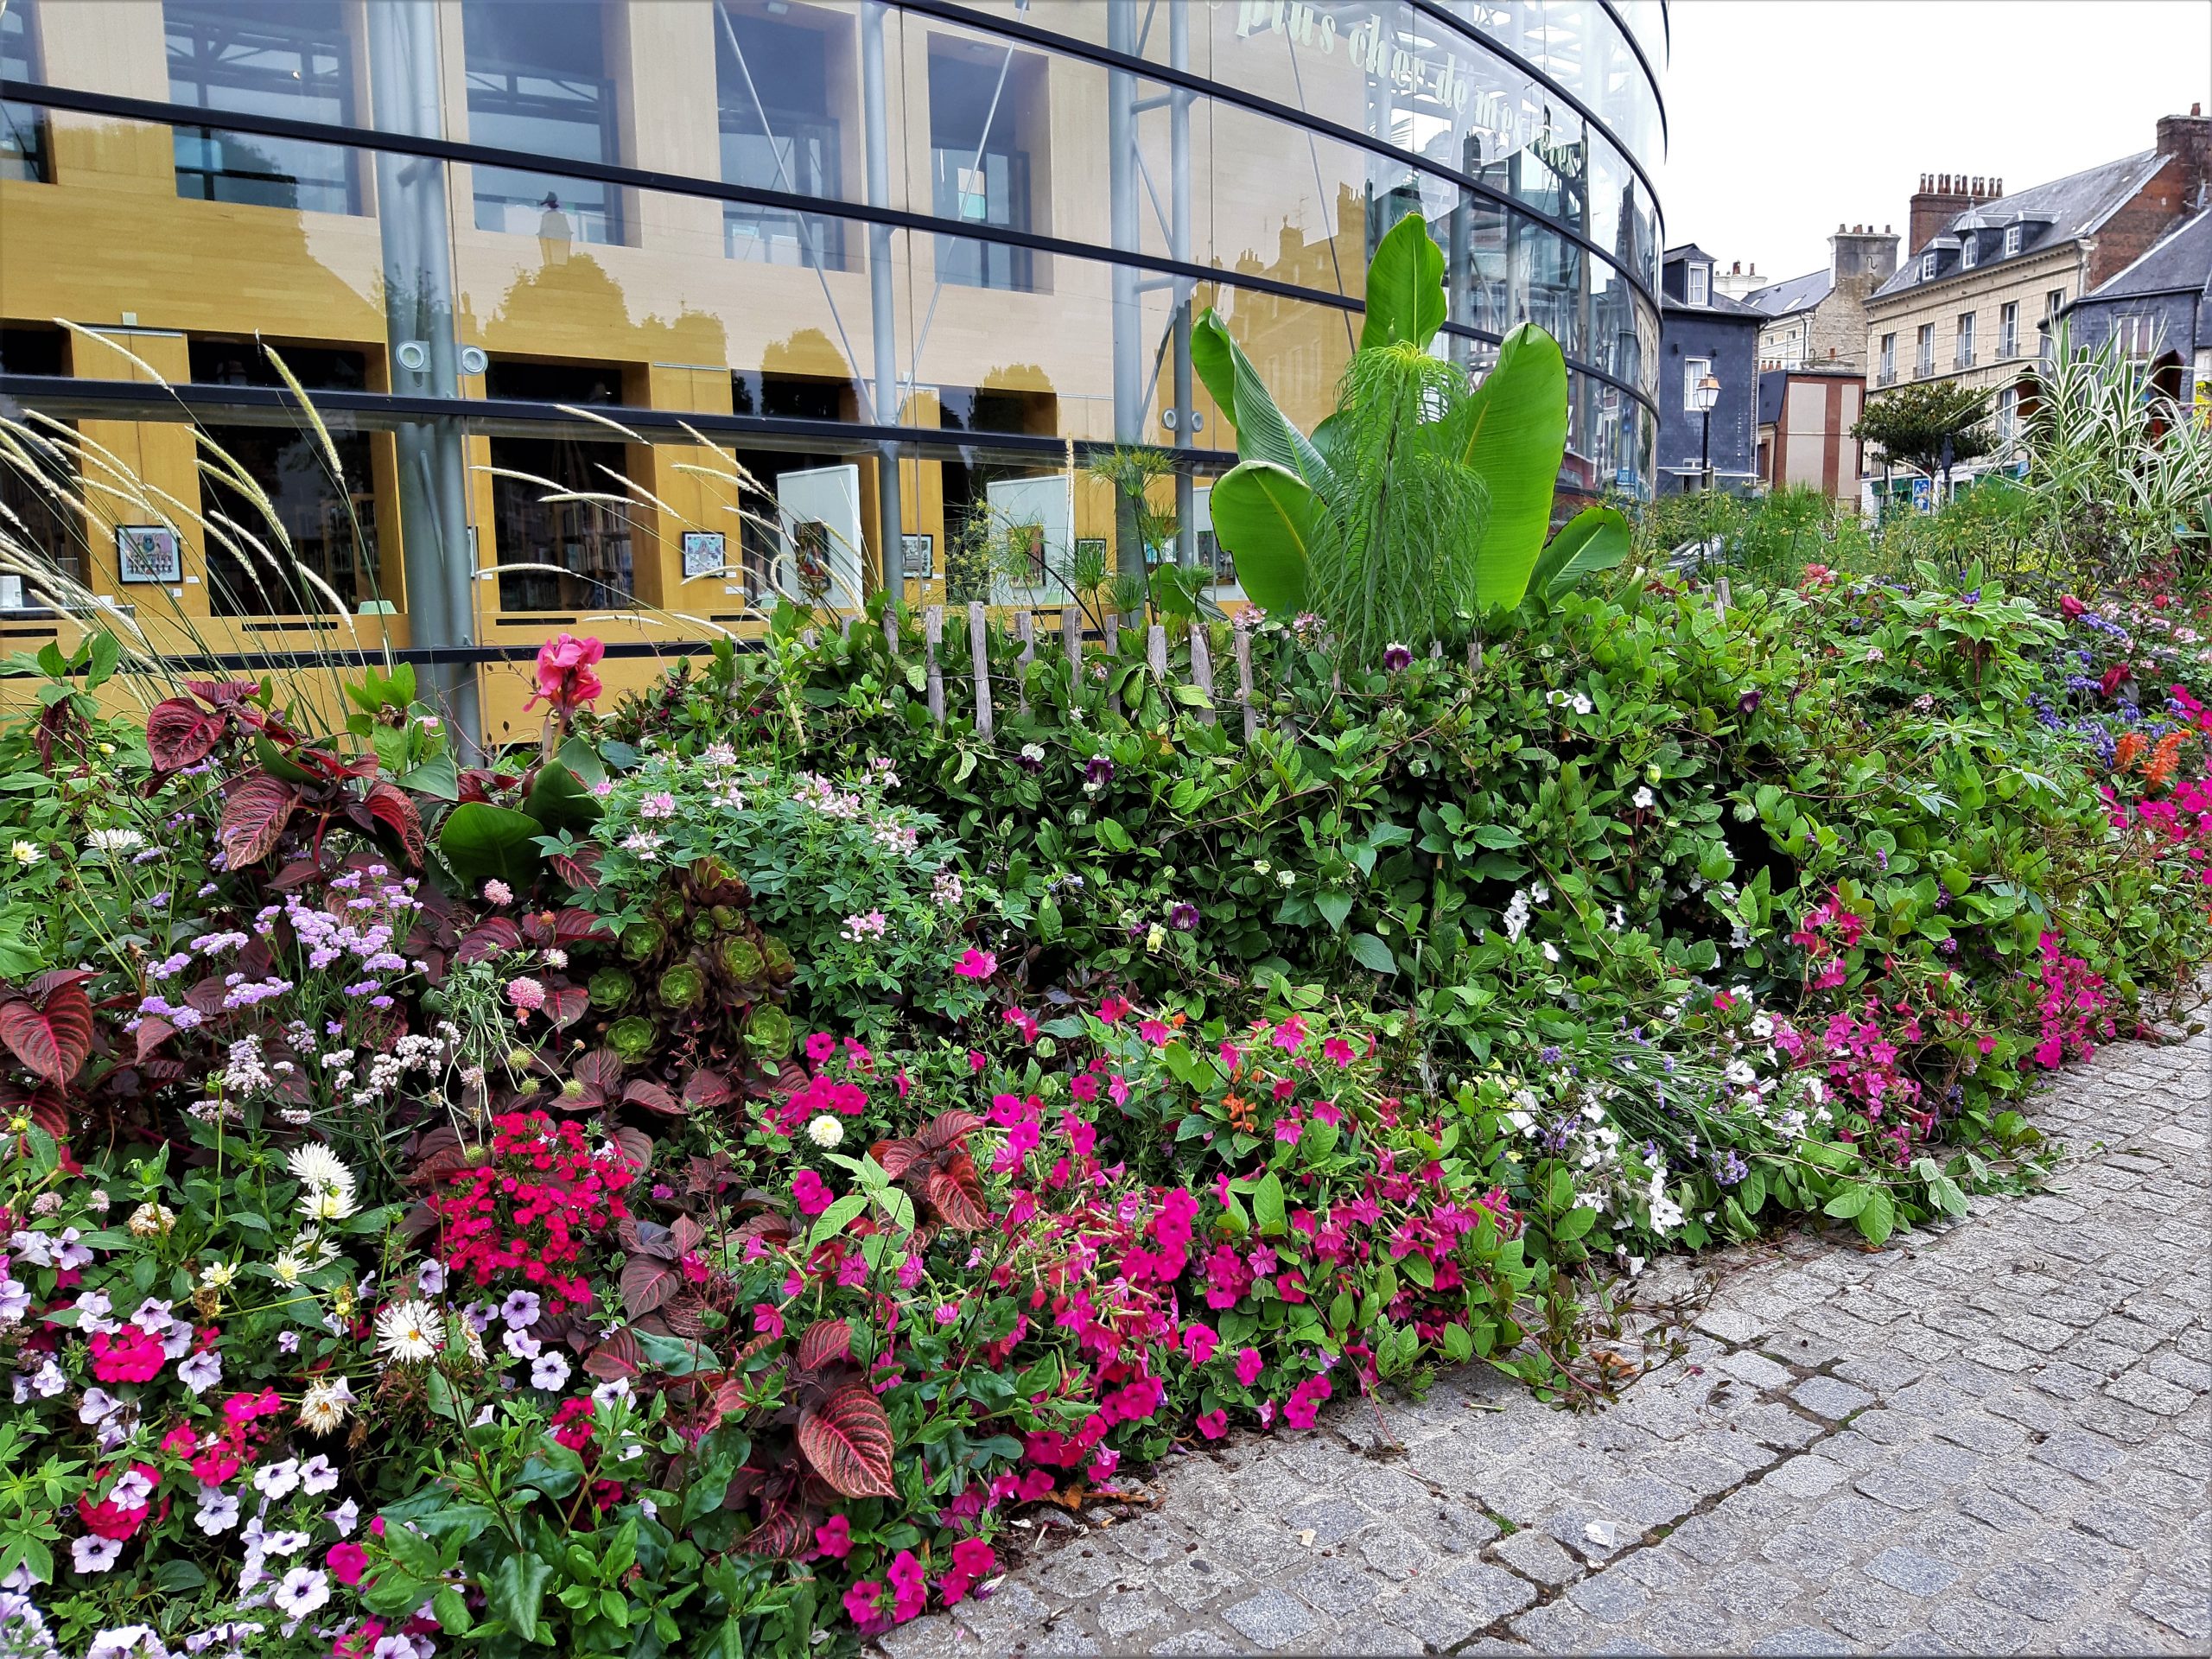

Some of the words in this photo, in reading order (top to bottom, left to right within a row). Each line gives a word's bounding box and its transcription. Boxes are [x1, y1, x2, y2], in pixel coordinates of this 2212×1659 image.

[1349, 14, 1426, 93] cher
[1435, 52, 1468, 115] de
[1475, 90, 1522, 148] mes
